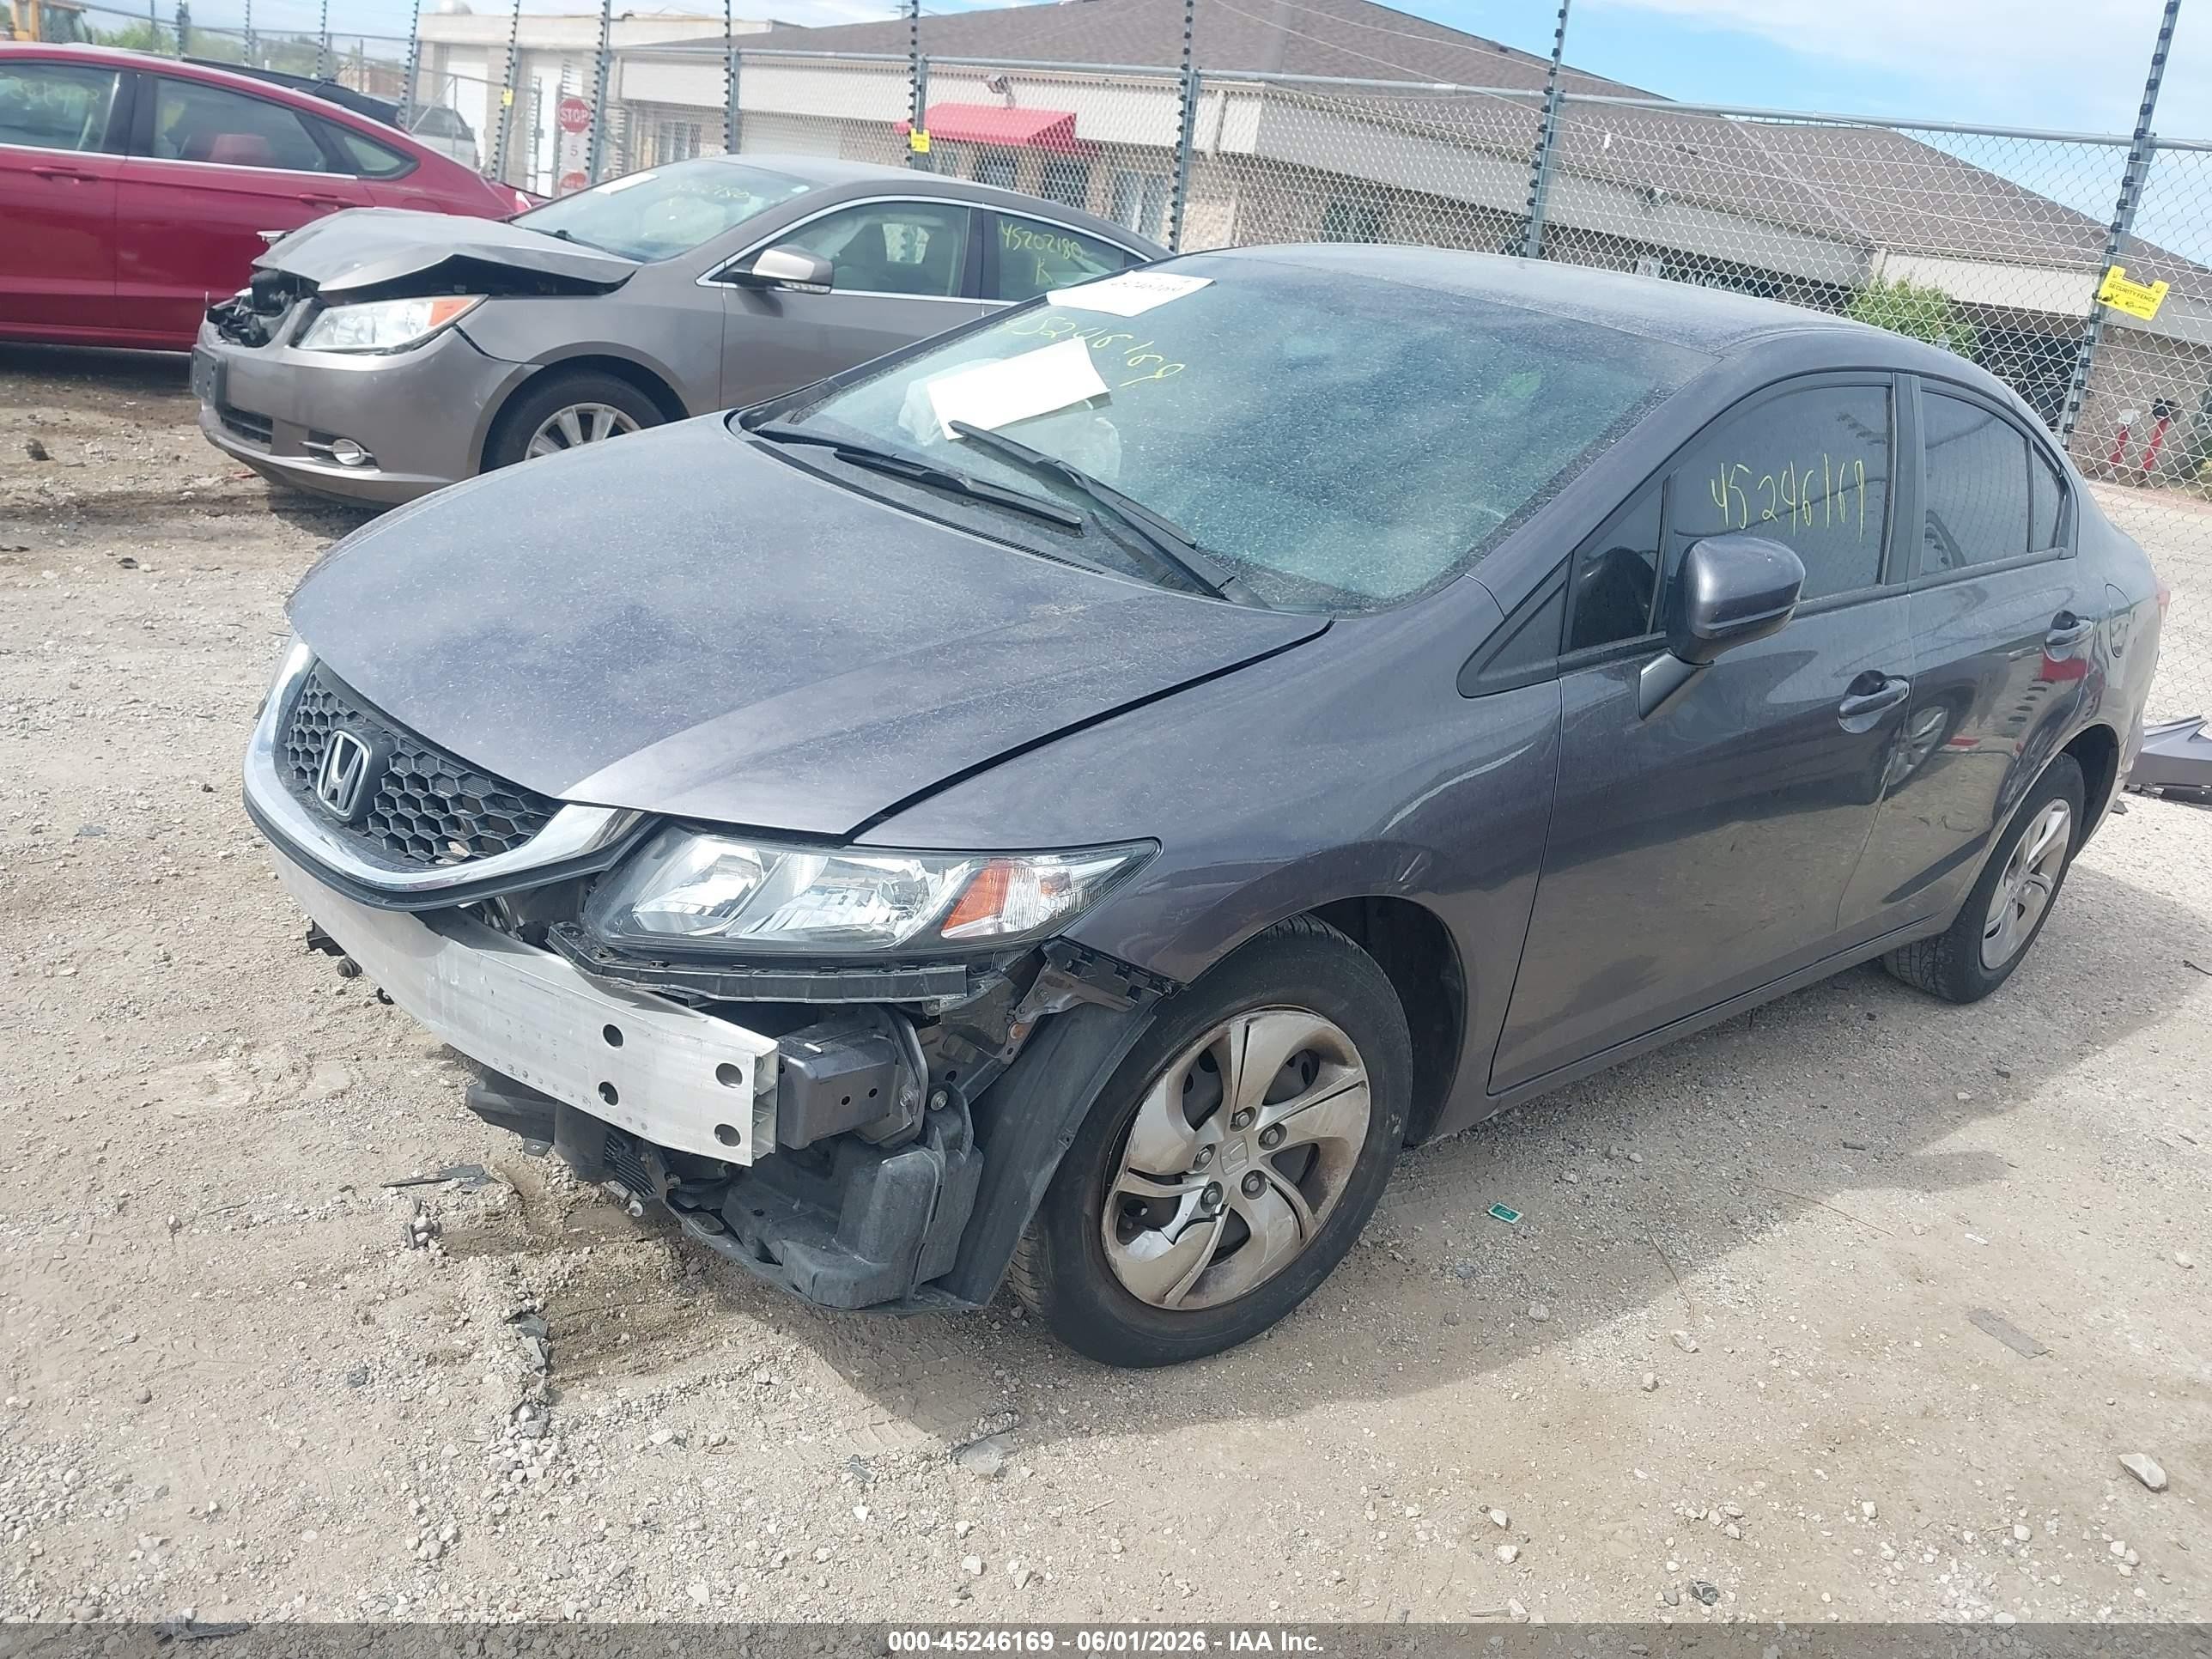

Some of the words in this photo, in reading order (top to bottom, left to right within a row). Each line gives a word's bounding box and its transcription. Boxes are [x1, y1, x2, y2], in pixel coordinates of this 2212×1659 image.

[561, 108, 589, 123] STOP
[570, 144, 578, 157] 5
[1000, 219, 1084, 260] 45202180
[2108, 282, 2136, 295] SECURITY
[2136, 292, 2157, 303] FENCE
[1711, 453, 1865, 543] 45246169
